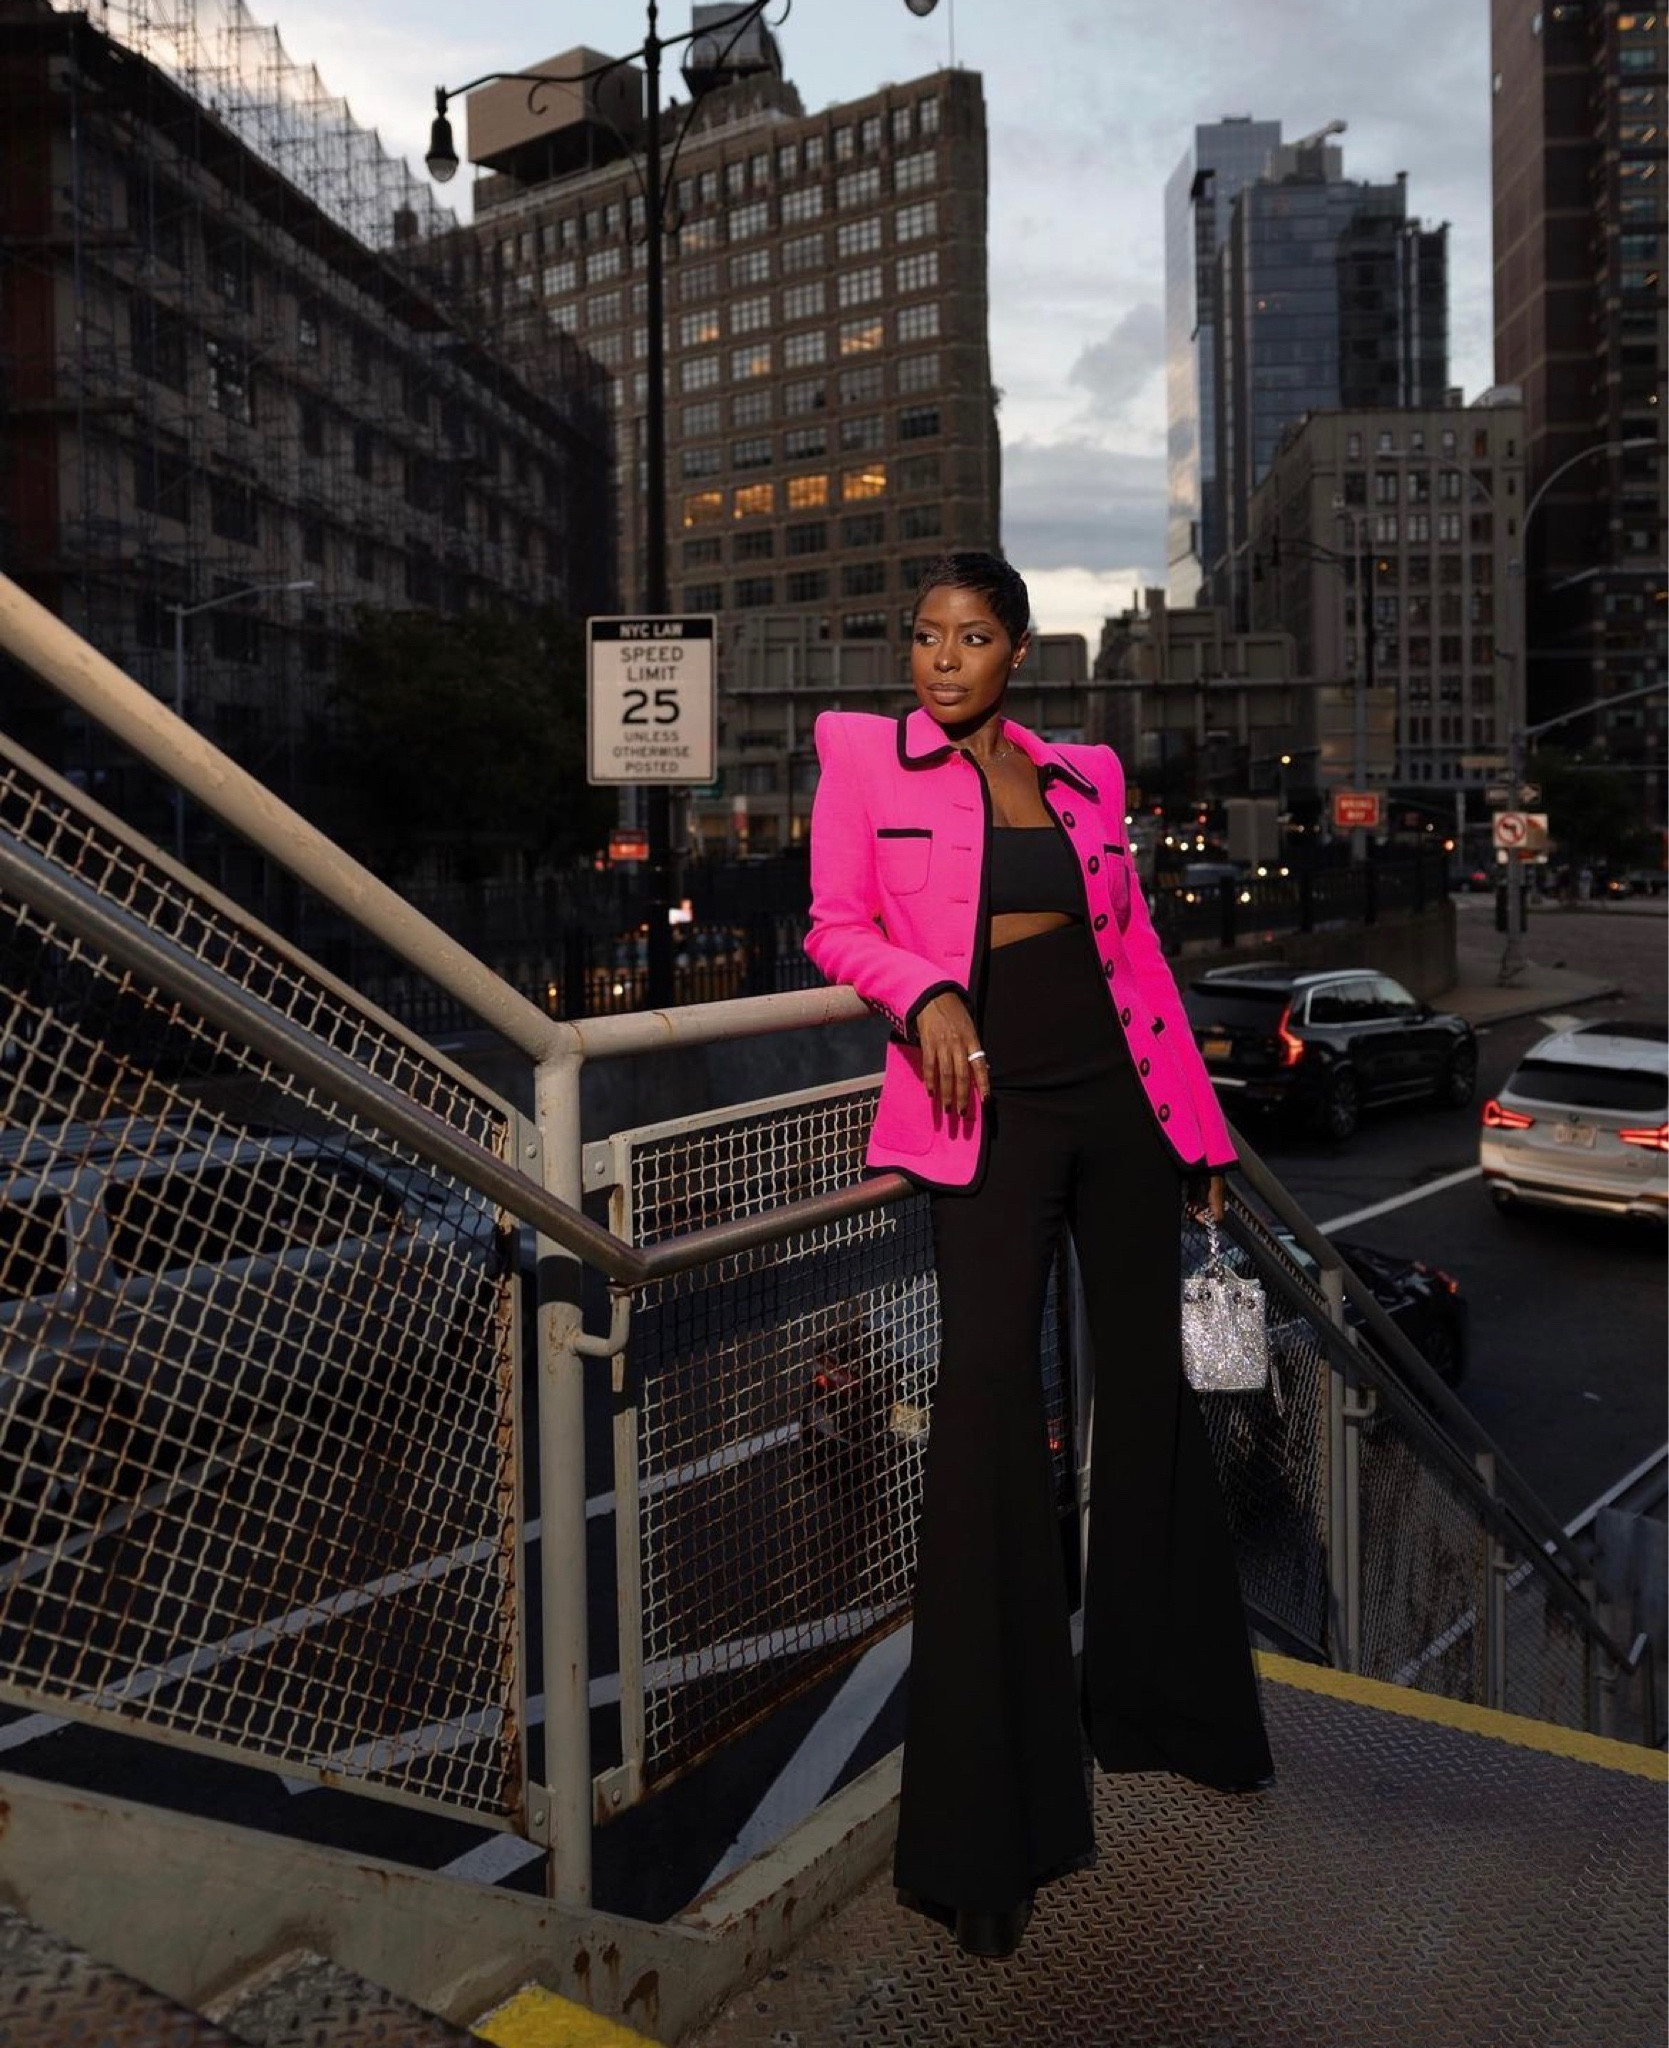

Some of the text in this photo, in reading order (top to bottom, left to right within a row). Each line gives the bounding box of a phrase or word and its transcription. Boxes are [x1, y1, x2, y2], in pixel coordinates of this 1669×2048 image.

[620, 623, 683, 638] NYC LAW
[621, 647, 684, 662] SPEED
[627, 666, 677, 682] LIMIT
[622, 689, 680, 724] 25
[624, 731, 680, 742] UNLESS
[613, 746, 690, 758] OTHERWISE
[625, 762, 679, 773] POSTED
